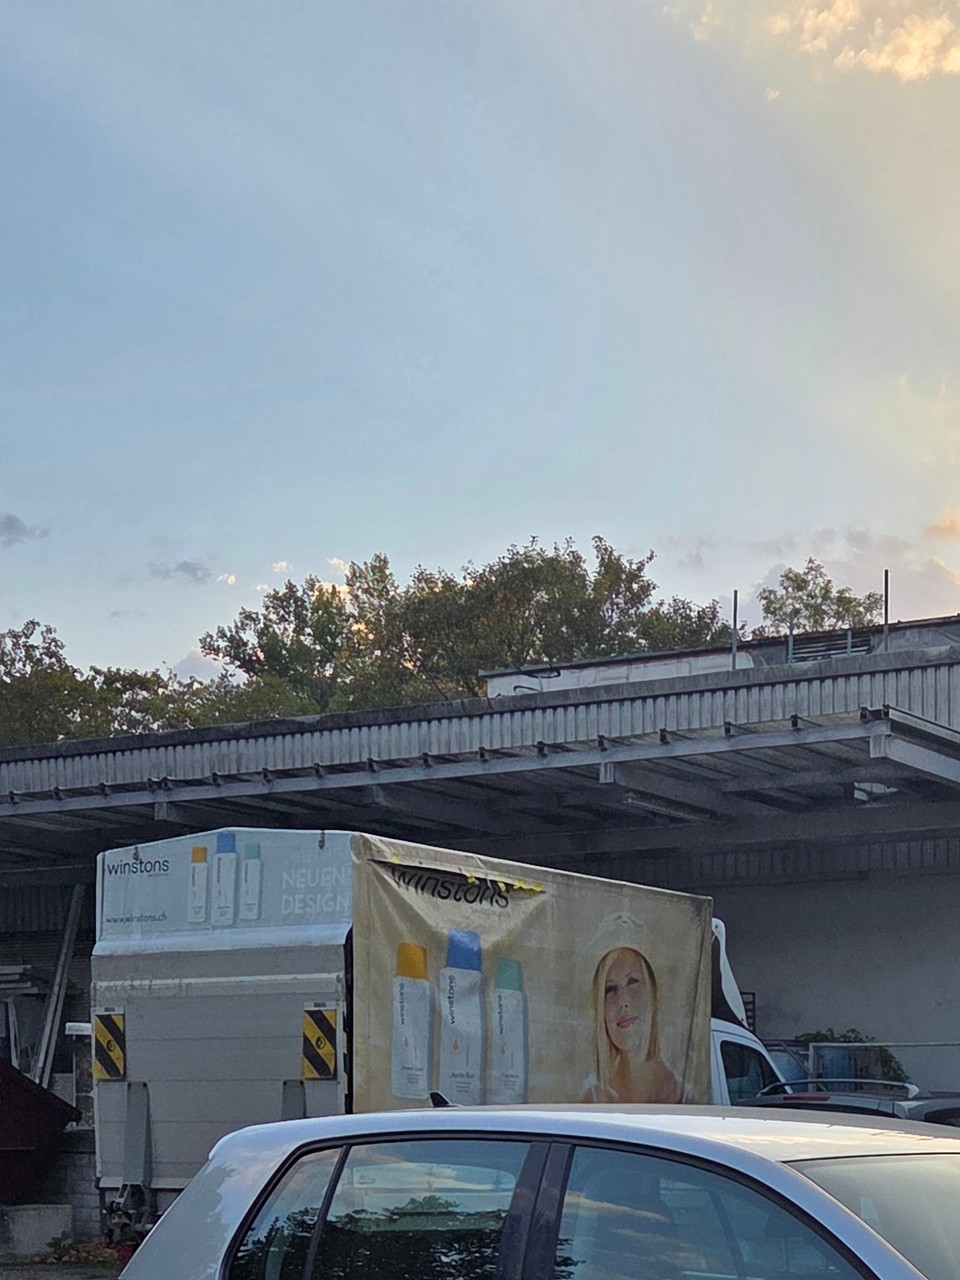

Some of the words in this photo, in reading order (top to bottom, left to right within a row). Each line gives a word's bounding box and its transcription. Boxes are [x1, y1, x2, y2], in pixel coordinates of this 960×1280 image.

[107, 858, 170, 875] winstons
[282, 866, 346, 889] NEUEN
[281, 891, 350, 914] DESIGN
[448, 974, 456, 1025] winstons
